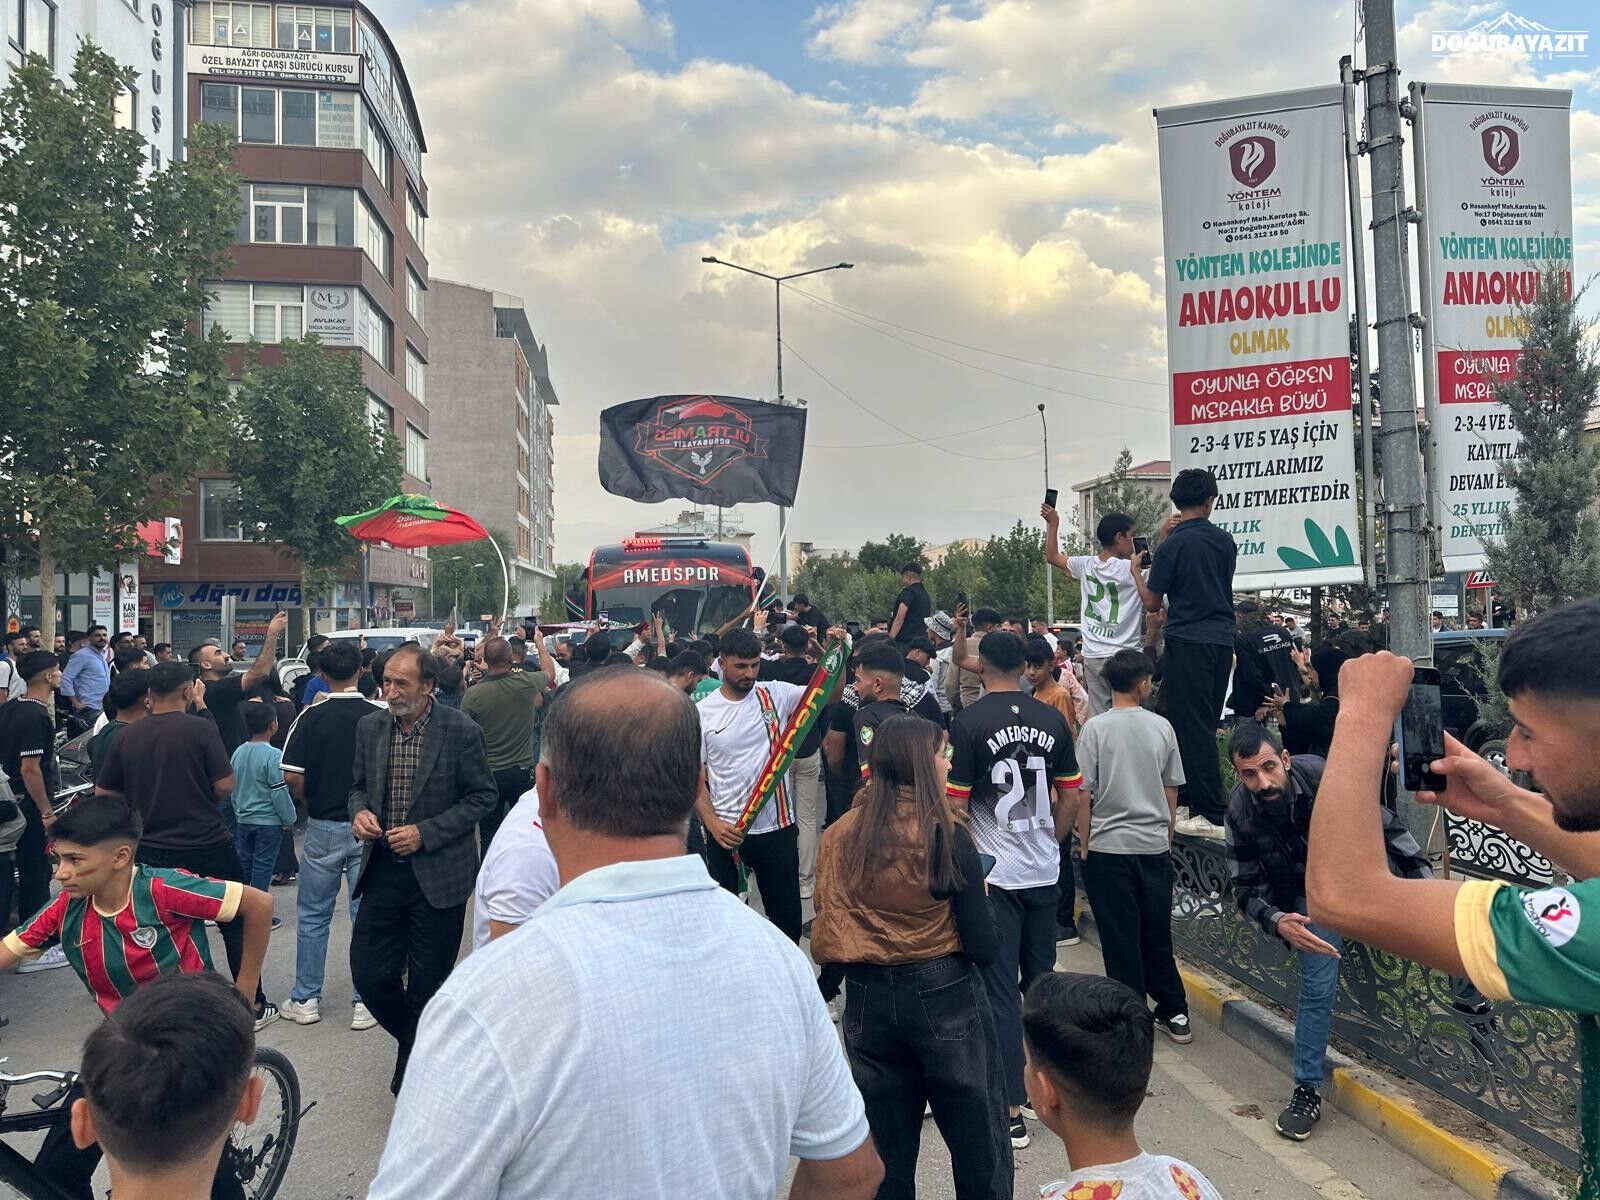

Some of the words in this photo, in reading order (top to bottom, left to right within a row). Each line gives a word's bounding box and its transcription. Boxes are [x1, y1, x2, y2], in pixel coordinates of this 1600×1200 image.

[202, 54, 223, 66] ÖZEL
[226, 56, 259, 67] BAYAZIT
[262, 60, 287, 71] ÇARŞI
[289, 60, 322, 72] SÜRÜCÜ
[325, 64, 353, 73] KURSU
[241, 49, 310, 60] AĞRI-DOĞUBAYAZIT
[1469, 111, 1502, 131] DOĞUBAYAZIT
[1504, 111, 1530, 132] KAMPÜSÜ
[1215, 121, 1257, 147] DOĞUBAYAZIT
[1258, 121, 1290, 139] KAMPÜSÜ
[1480, 176, 1525, 185] YÖNTEM
[1227, 187, 1281, 201] YÖNTEM
[1491, 188, 1516, 198] koleji
[1239, 199, 1270, 211] koleji
[1218, 227, 1238, 235] No:17
[1234, 232, 1252, 241] 0541
[1254, 231, 1267, 239] 312
[1440, 231, 1498, 260] YÖNTEM
[1500, 231, 1572, 261] KOLEJİNDE
[1176, 252, 1245, 282] YÖNTEM
[1249, 239, 1341, 276] KOLEJİNDE
[1179, 276, 1342, 327] ANAOKULLU
[1229, 327, 1291, 355] OLMAK
[1454, 356, 1510, 375] OYUNLA
[1190, 371, 1260, 395] OYUNLA
[1266, 364, 1333, 388] ÖĞREN
[1191, 396, 1274, 421] MERAKLA
[1280, 389, 1327, 411] BÜYÜ
[1454, 415, 1486, 432] 2-3-4
[1489, 414, 1506, 431] VE
[1190, 434, 1230, 453] 2-3-4
[1233, 430, 1254, 449] VE
[1257, 430, 1266, 448] 5
[1270, 427, 1299, 449] YAŞ
[1302, 420, 1338, 448] İÇİN
[1449, 473, 1494, 491] DEVAM
[1243, 479, 1350, 508] ETMEKTEDİR
[1453, 503, 1469, 517] 25
[1450, 521, 1505, 538] DENEYİ
[623, 566, 720, 584] AMEDSPOR
[123, 603, 135, 611] KAN
[1084, 574, 1119, 624] 21
[986, 725, 1055, 756] AMEDSPOR
[991, 756, 1055, 832] 21
